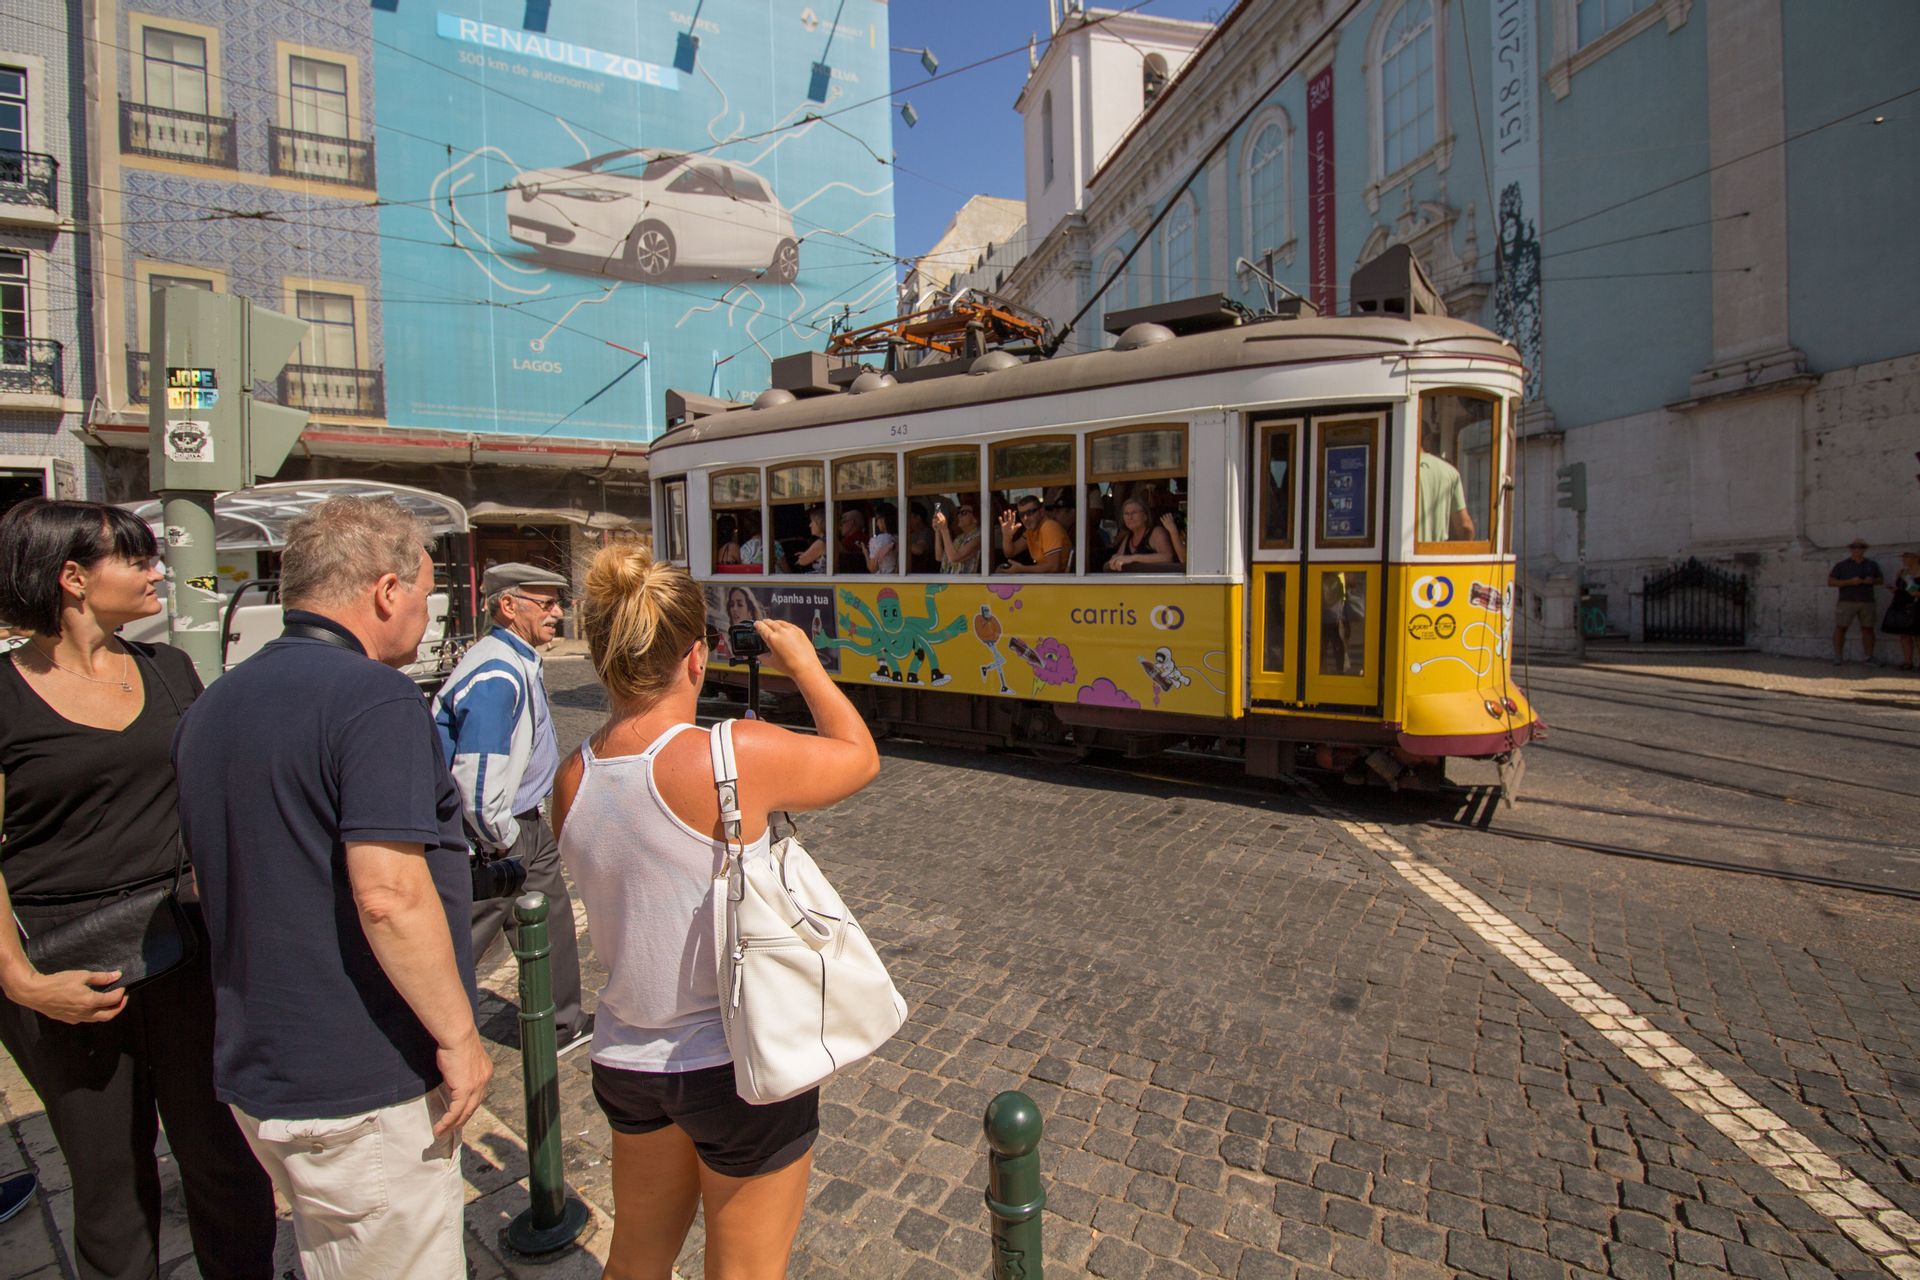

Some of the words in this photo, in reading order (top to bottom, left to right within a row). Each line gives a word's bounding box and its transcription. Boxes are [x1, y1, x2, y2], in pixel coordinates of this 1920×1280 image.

[459, 18, 596, 69] RENAULT
[603, 54, 662, 85] ZOE
[458, 51, 484, 66] 300
[488, 56, 509, 73] km
[512, 61, 530, 77] de
[1311, 75, 1330, 97] 500
[1498, 0, 1522, 154] 1518-201
[1316, 130, 1327, 191] LORETO
[1317, 196, 1326, 213] DI
[1318, 216, 1328, 293] MADONNA
[512, 358, 562, 373] LAGOS
[170, 370, 213, 387] JOPE
[173, 391, 214, 408] JOPE
[890, 424, 908, 436] 543
[771, 593, 804, 605] Apanha
[806, 596, 812, 605] a
[813, 594, 829, 605] tua
[1071, 602, 1137, 626] carris
